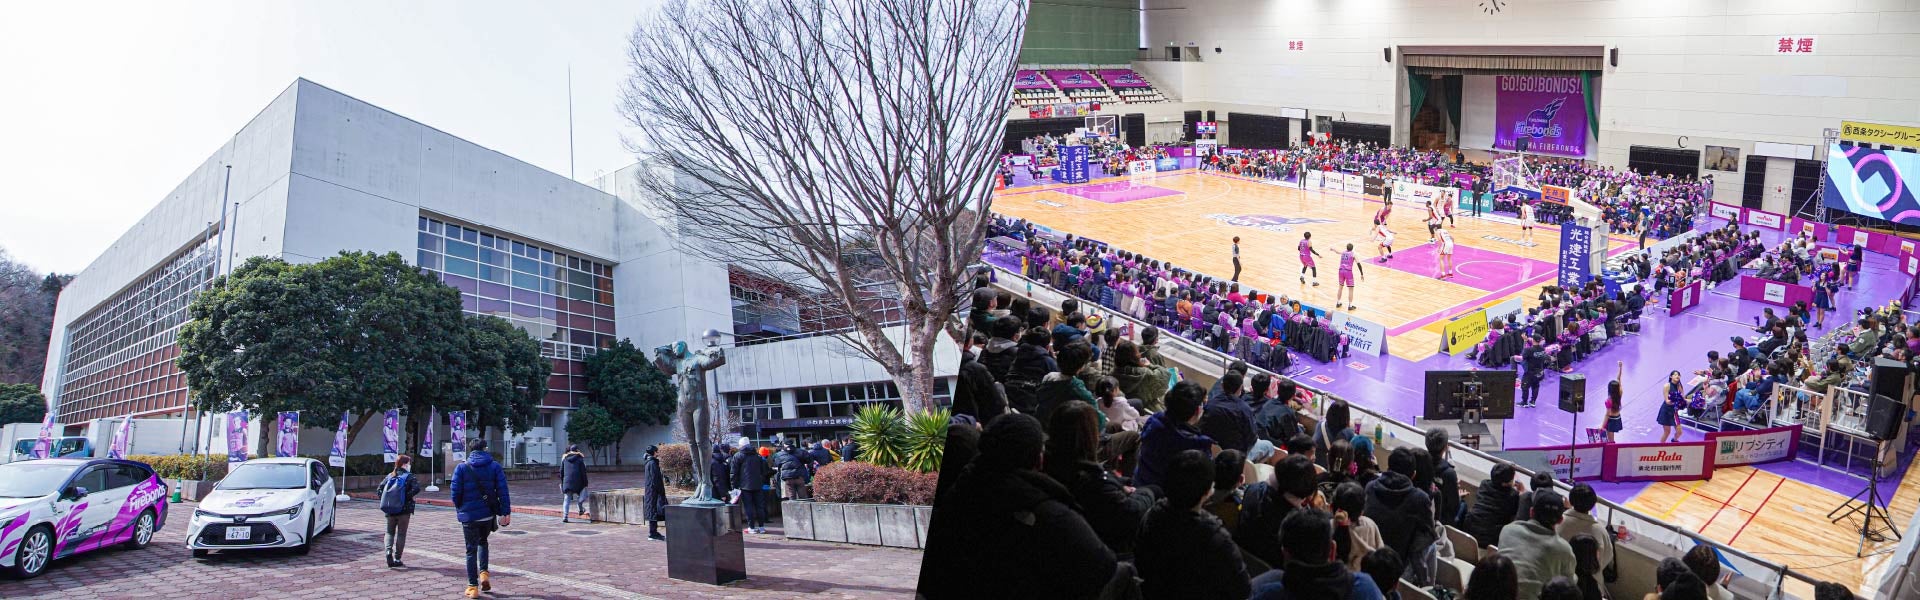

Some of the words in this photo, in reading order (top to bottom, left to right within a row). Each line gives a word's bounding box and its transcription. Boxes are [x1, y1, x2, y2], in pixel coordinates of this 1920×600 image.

[1778, 37, 1814, 53] 禁煙
[1340, 111, 1346, 121] A
[1515, 121, 1562, 137] Firebonds
[1678, 135, 1689, 148] C
[1567, 228, 1583, 285] 光建工業
[1639, 450, 1683, 462] muRata
